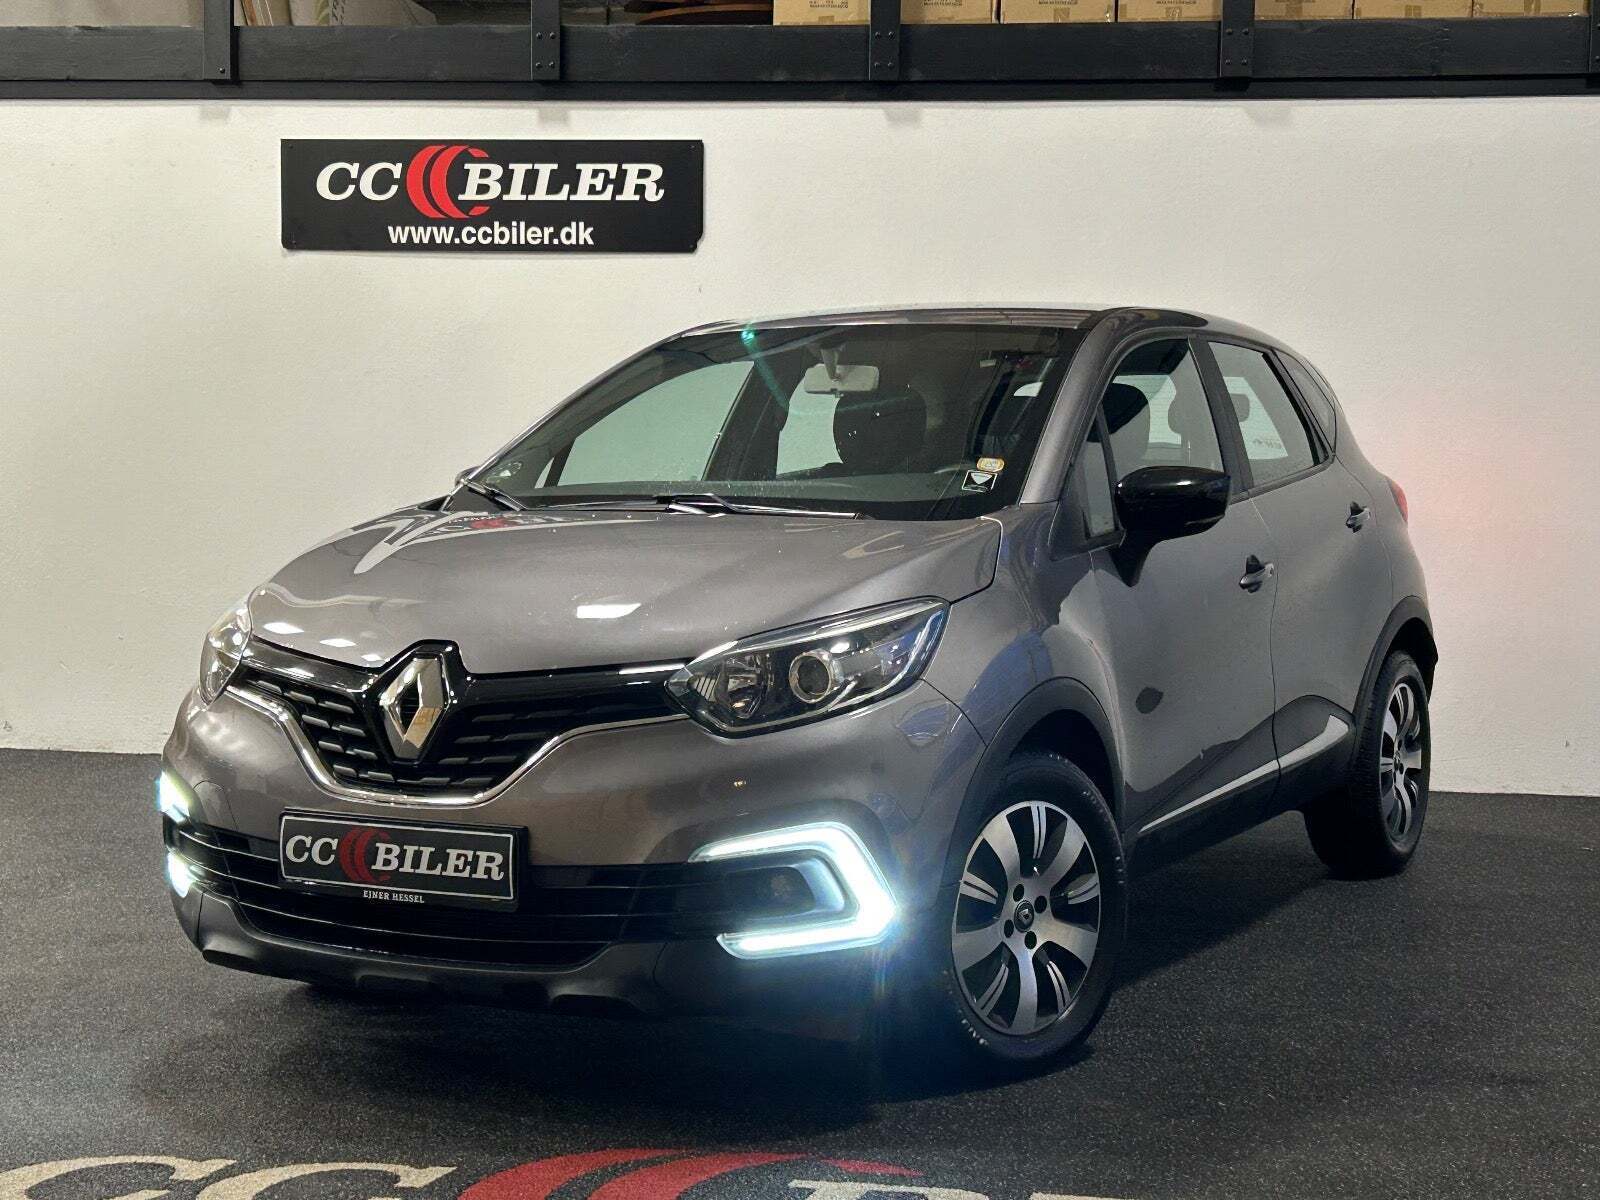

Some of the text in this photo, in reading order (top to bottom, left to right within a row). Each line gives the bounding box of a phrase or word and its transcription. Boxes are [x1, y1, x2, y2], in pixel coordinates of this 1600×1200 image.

[317, 161, 665, 202] CC BILER
[388, 220, 594, 246] www.ccbiler.dk
[285, 834, 504, 881] CC BILER
[392, 892, 425, 904] HESSEL
